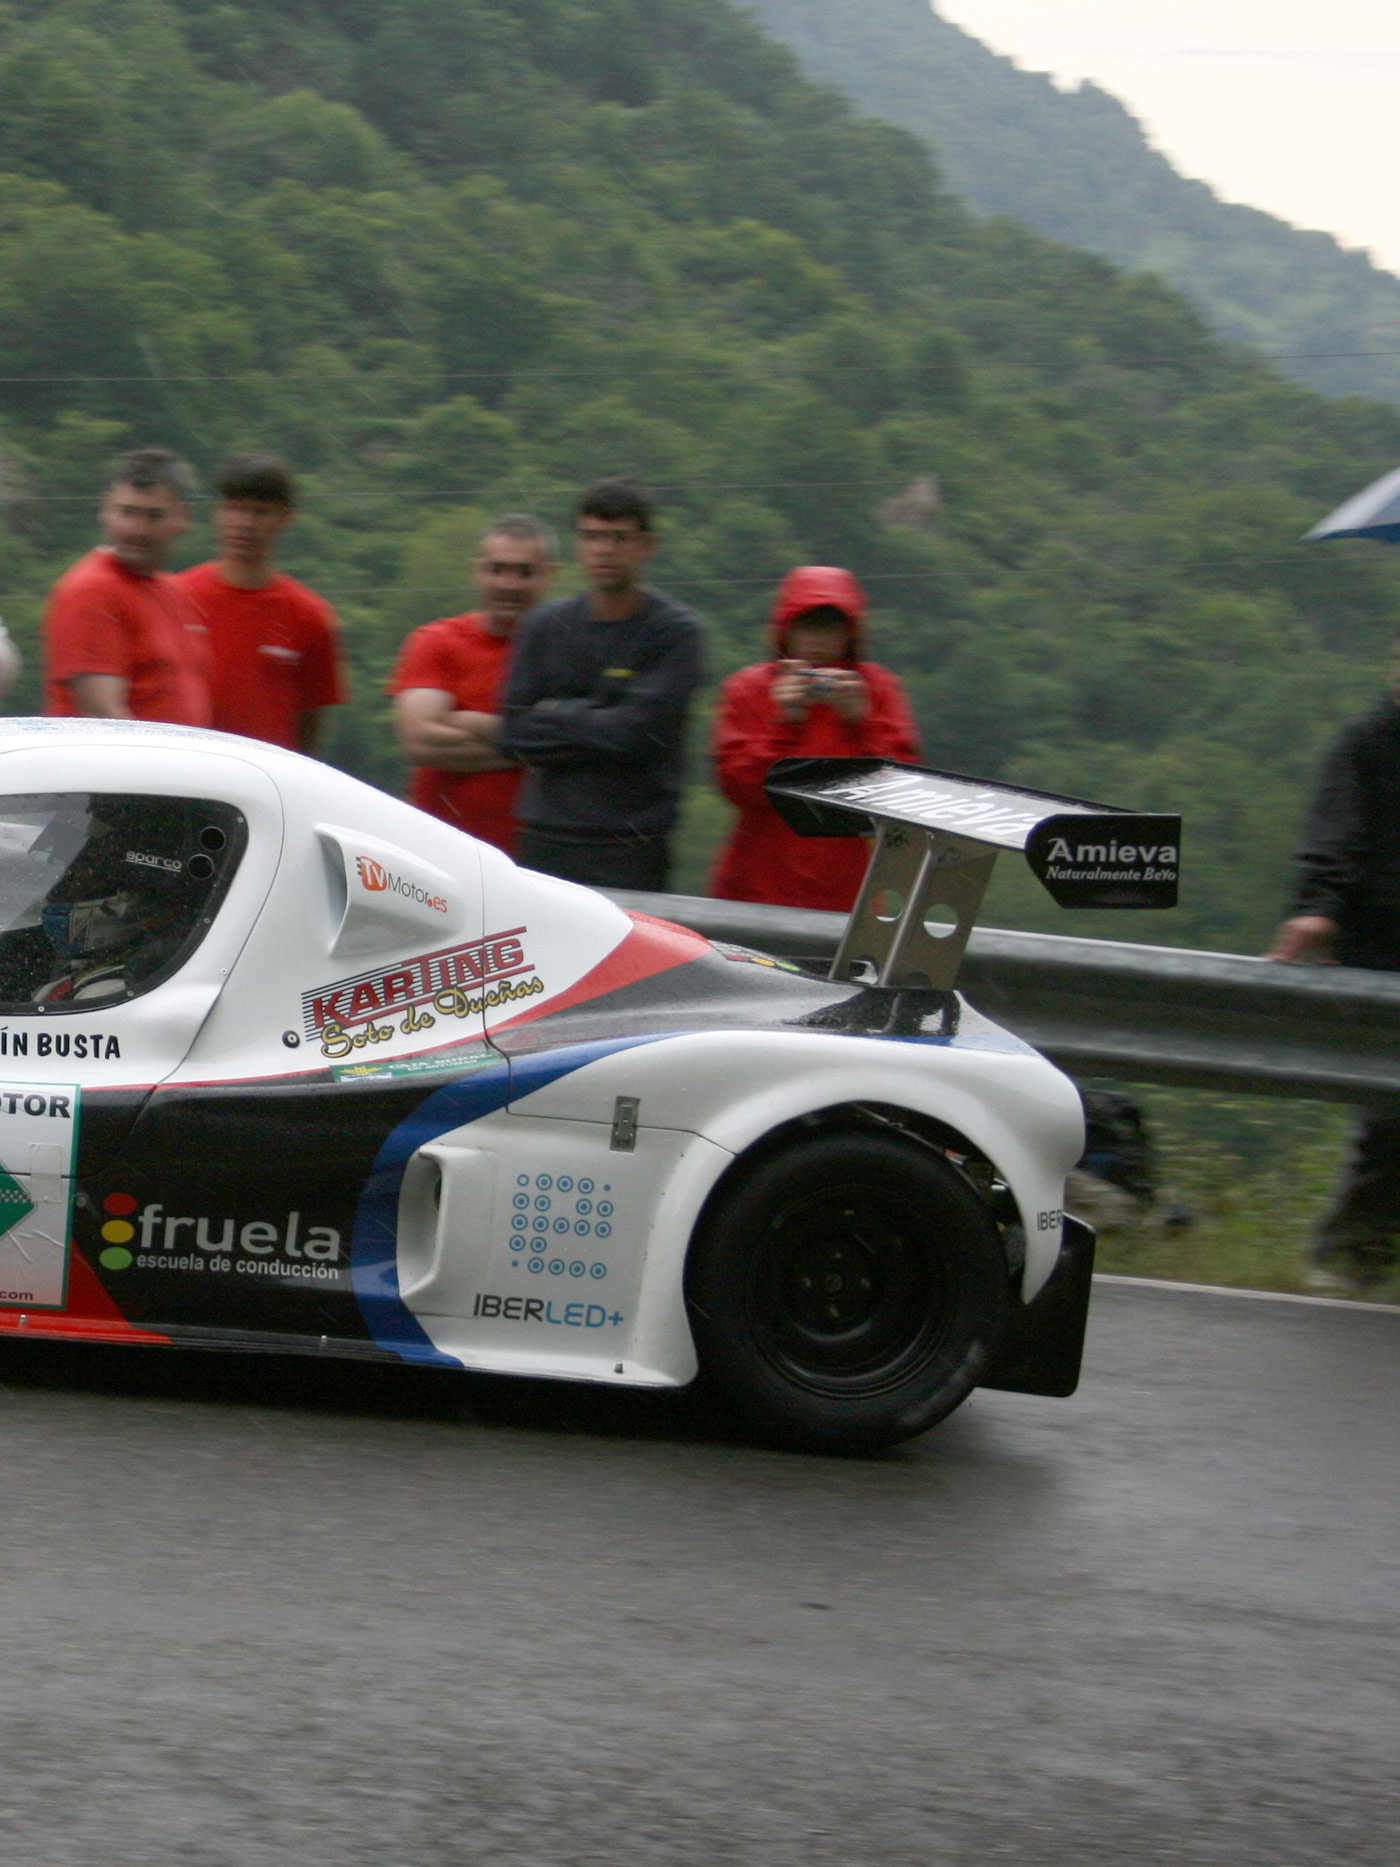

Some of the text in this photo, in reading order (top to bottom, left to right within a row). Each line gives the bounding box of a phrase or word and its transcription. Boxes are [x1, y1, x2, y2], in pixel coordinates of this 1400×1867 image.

[125, 850, 182, 873] sparco
[1046, 838, 1177, 863] Amieva
[1045, 866, 1141, 880] Naturalmente
[312, 937, 524, 1028] KARTING
[320, 975, 544, 1059] Soto de Dueñas
[37, 1033, 121, 1060] BUSTA
[138, 1203, 341, 1262] fruela
[136, 1253, 340, 1281] escuela de conducción
[473, 1293, 624, 1328] IBERLED+
